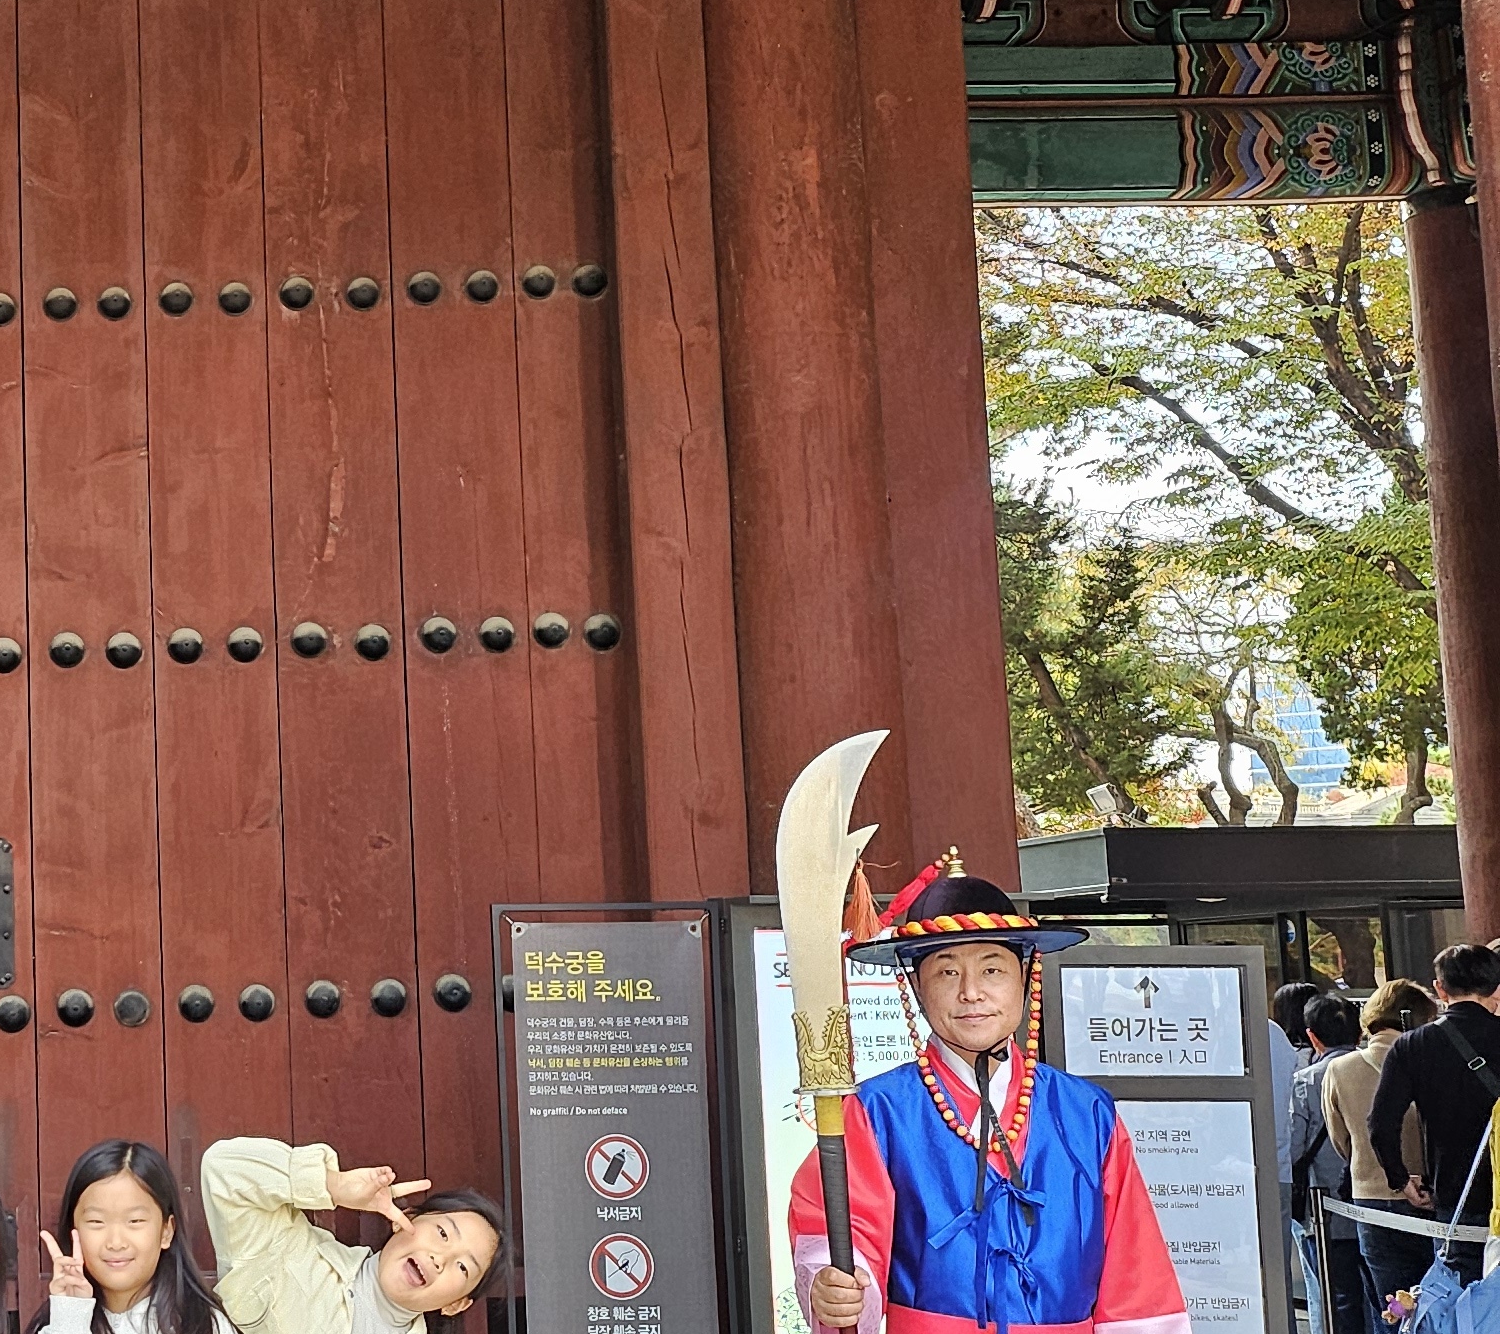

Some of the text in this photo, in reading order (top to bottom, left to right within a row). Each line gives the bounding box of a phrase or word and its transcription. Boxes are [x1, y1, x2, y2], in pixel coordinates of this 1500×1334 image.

[525, 951, 605, 975] 덕수궁을
[525, 979, 587, 1002] 보호해
[851, 996, 900, 1005] roved dro
[876, 1011, 900, 1020] KRW
[1087, 1017, 1209, 1042] 들어가는 곳
[1100, 1050, 1163, 1064] Entrance
[530, 1107, 541, 1116] No
[543, 1106, 569, 1117] graffiti
[575, 1106, 586, 1115] Do
[588, 1107, 601, 1115] not
[602, 1107, 628, 1115] deface
[1135, 1130, 1191, 1142] 전 지역 금연
[1148, 1147, 1180, 1155] smoking
[1148, 1184, 1245, 1197] 식물(도시락) 반입금지
[597, 1206, 642, 1221] 낙서금지
[1182, 1241, 1221, 1252] 반입금지
[1211, 1297, 1250, 1309] 반입금지
[587, 1306, 661, 1321] 창호 훼손 금지
